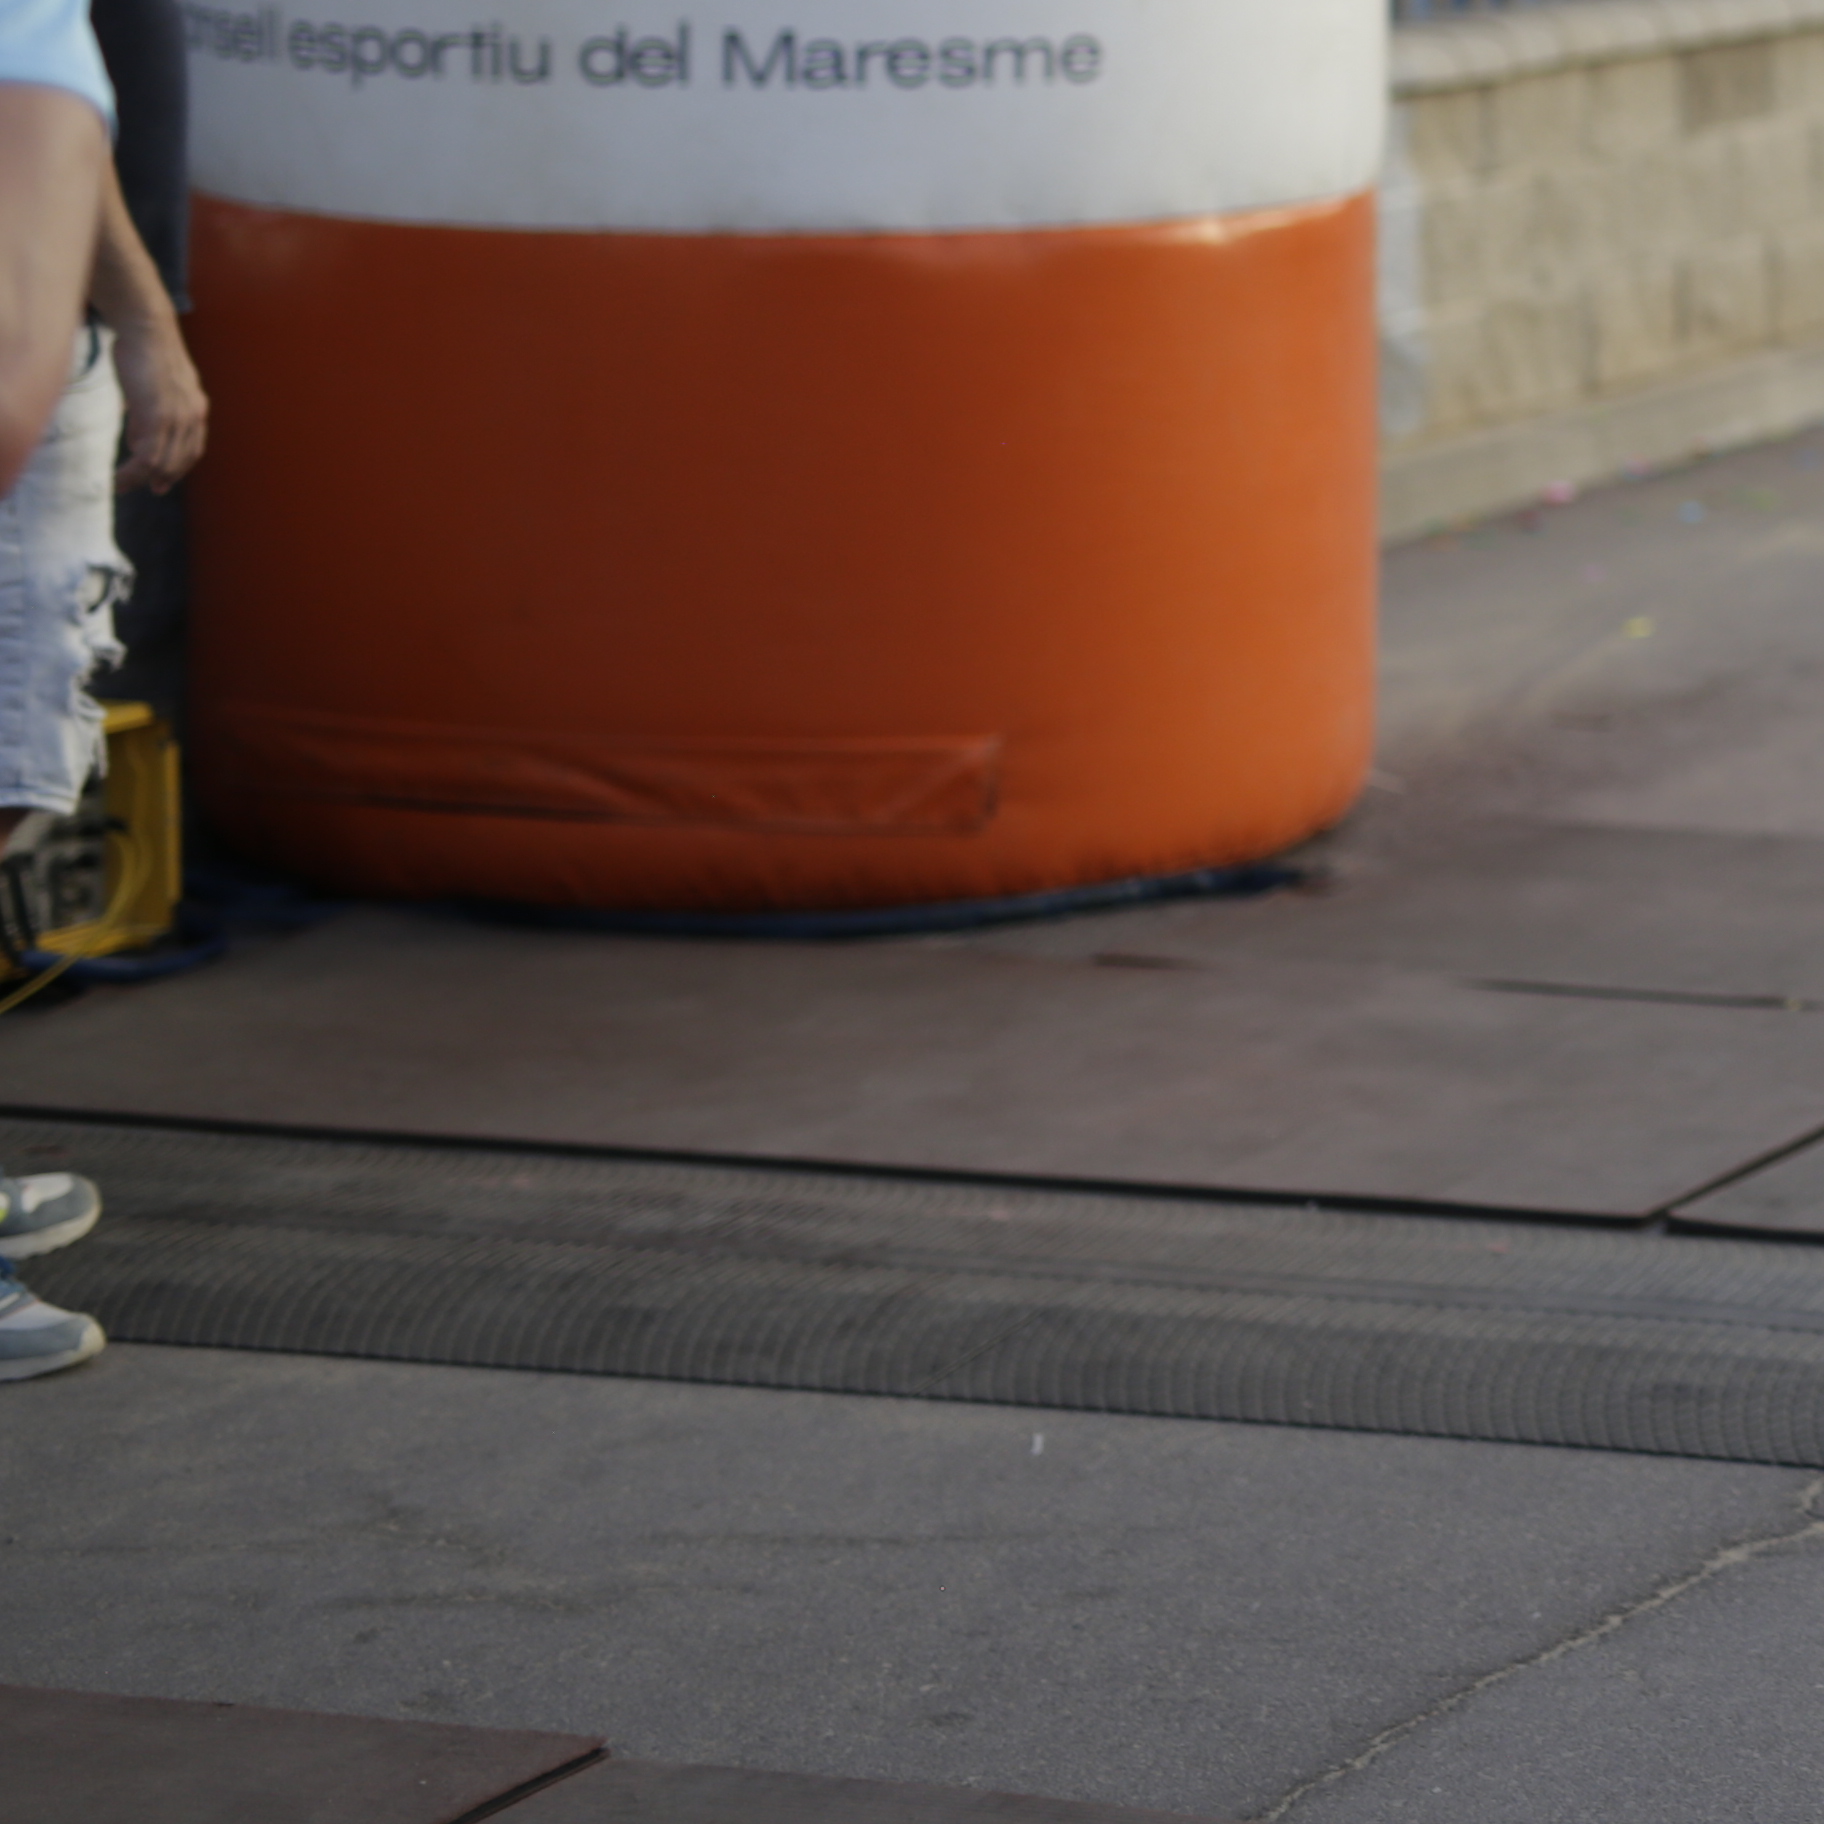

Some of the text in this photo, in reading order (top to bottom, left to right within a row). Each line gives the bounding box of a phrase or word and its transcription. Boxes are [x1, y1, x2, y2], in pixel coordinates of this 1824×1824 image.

[288, 18, 550, 90] esportiu
[577, 18, 692, 88] del
[720, 25, 1101, 90] Maresme
